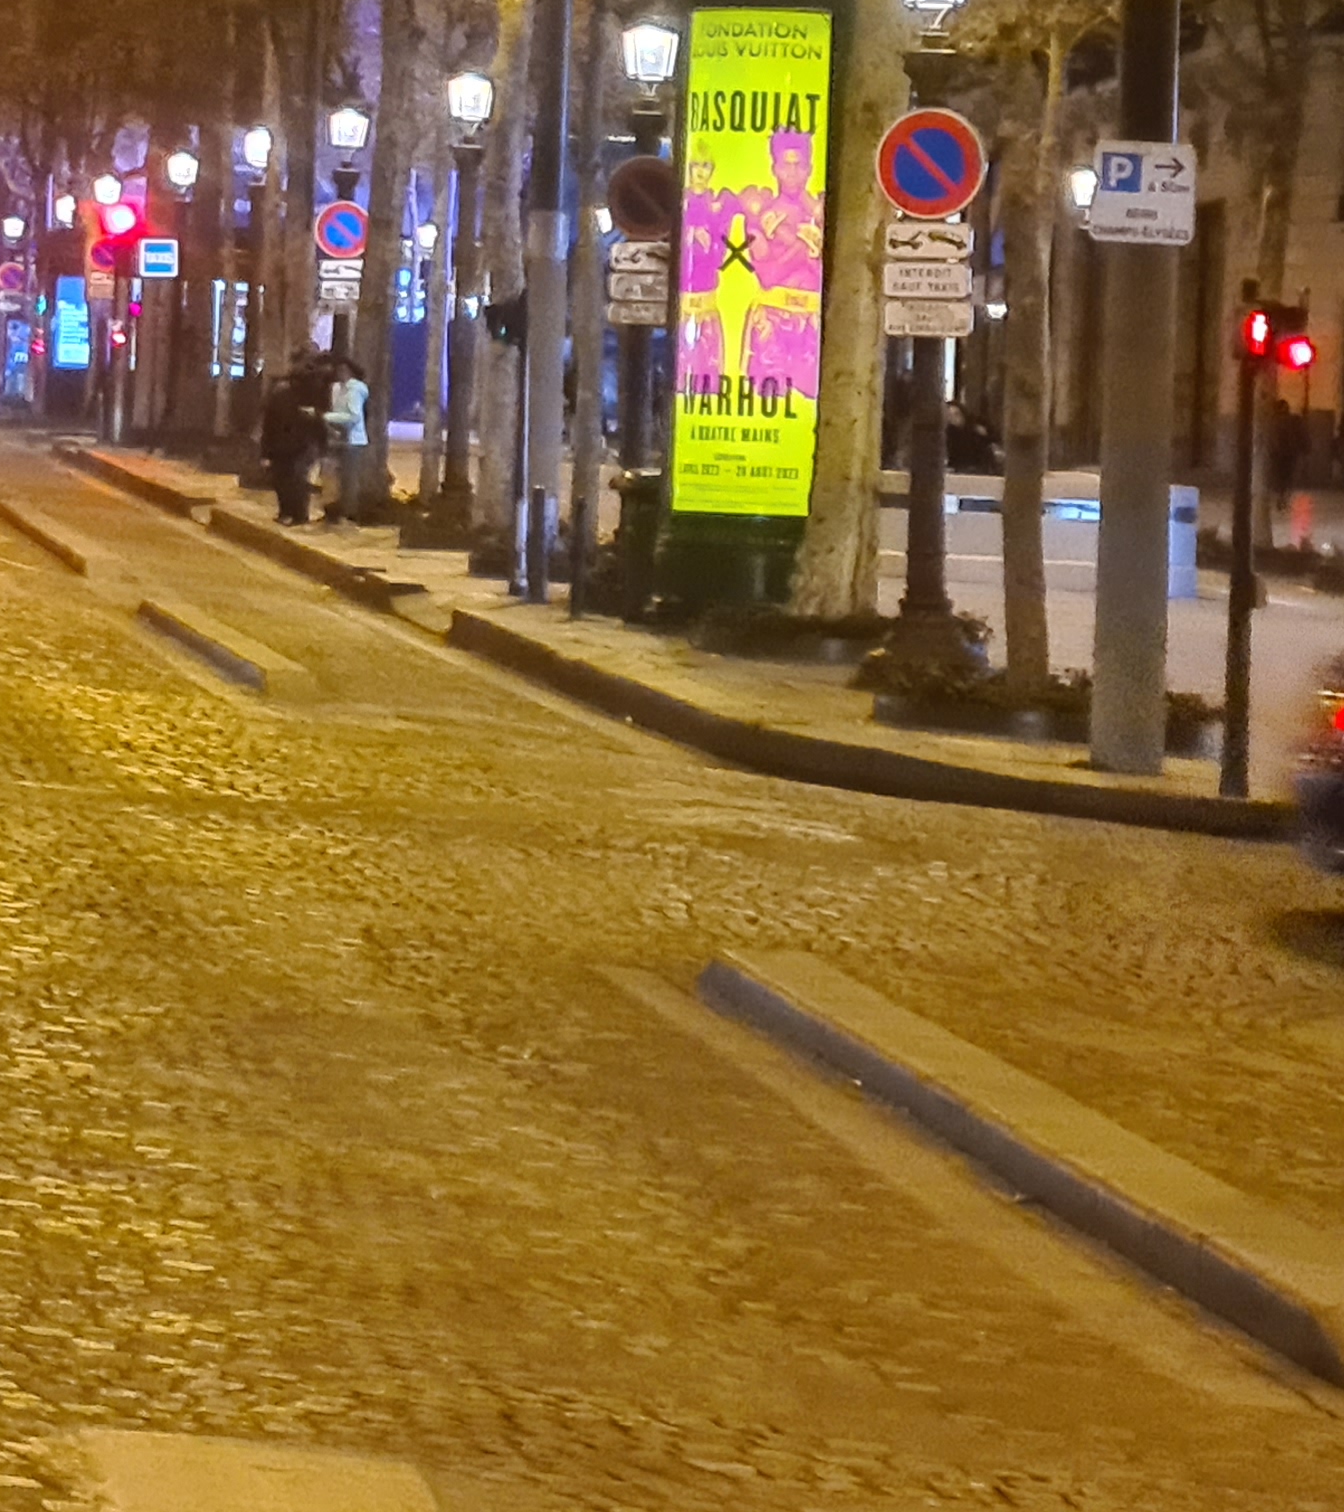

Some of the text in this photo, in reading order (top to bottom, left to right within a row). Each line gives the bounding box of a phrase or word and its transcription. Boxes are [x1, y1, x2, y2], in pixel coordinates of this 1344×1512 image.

[701, 21, 809, 40] ONDATION
[734, 42, 822, 60] VUITTON
[690, 90, 821, 134] BASQUIAT
[1109, 155, 1135, 188] P
[683, 372, 798, 419] WARHOL
